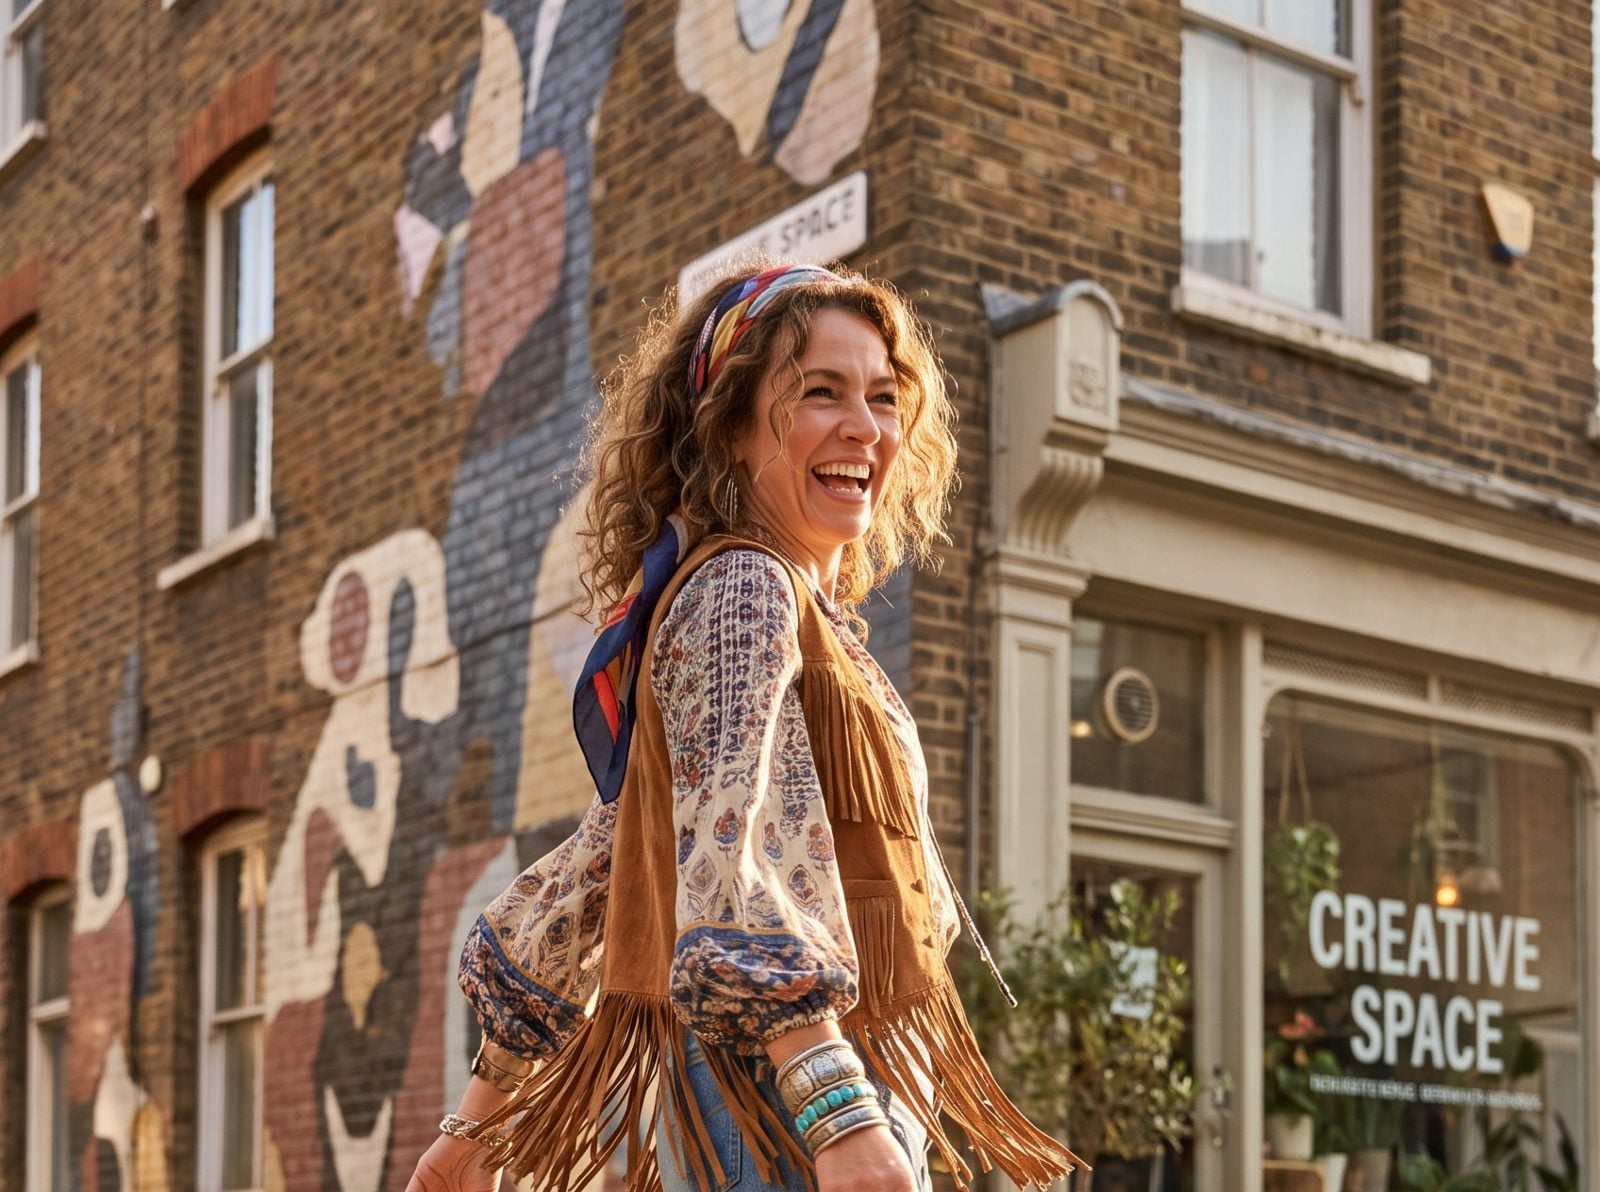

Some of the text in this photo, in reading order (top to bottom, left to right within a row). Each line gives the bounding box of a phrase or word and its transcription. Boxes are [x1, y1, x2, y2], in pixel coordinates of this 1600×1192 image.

[781, 189, 854, 254] SPACE
[1309, 889, 1540, 992] CREATIVE
[1350, 985, 1504, 1074] SPACE
